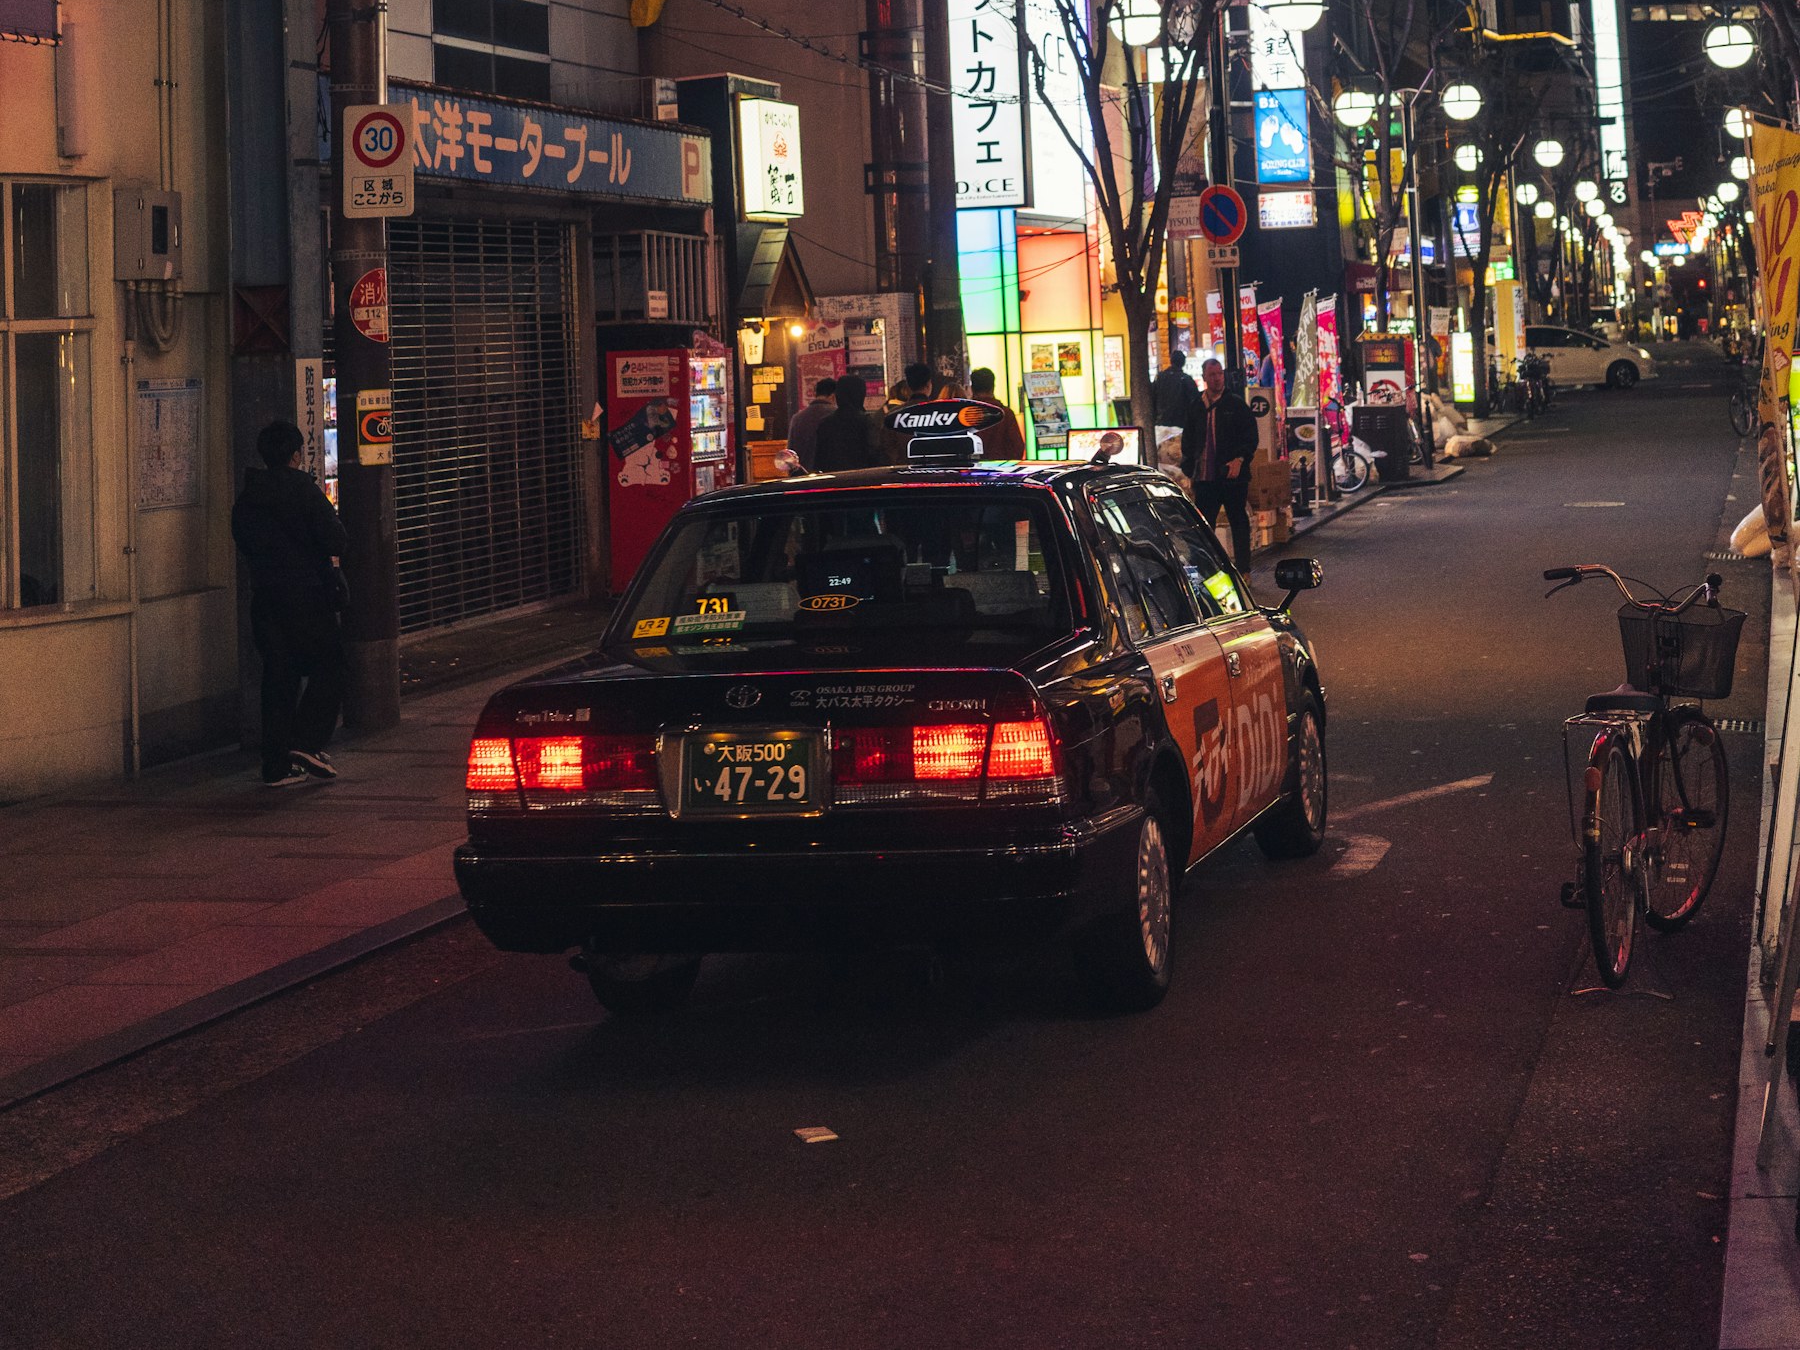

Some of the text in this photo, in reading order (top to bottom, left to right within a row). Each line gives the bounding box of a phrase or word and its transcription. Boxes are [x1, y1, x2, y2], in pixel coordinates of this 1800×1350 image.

[364, 127, 394, 152] 30
[683, 142, 700, 194] P
[364, 179, 394, 191] 区域
[354, 191, 404, 205] ここから
[1209, 248, 1237, 258] 自動車
[808, 338, 844, 352] EYELASH
[1252, 402, 1267, 413] 2F
[893, 411, 958, 429] Kanky
[829, 576, 852, 587] 22:49
[696, 598, 729, 615] 731
[811, 597, 846, 609] 0731
[639, 619, 666, 630] JR 2
[816, 684, 915, 695] OSAKA BUS GROUP
[816, 696, 915, 709] 大バス太平タクシー
[928, 698, 986, 711] CROWN
[717, 743, 786, 762] 大阪500
[1237, 682, 1281, 810] DiDi
[694, 764, 806, 801] い 47-29
